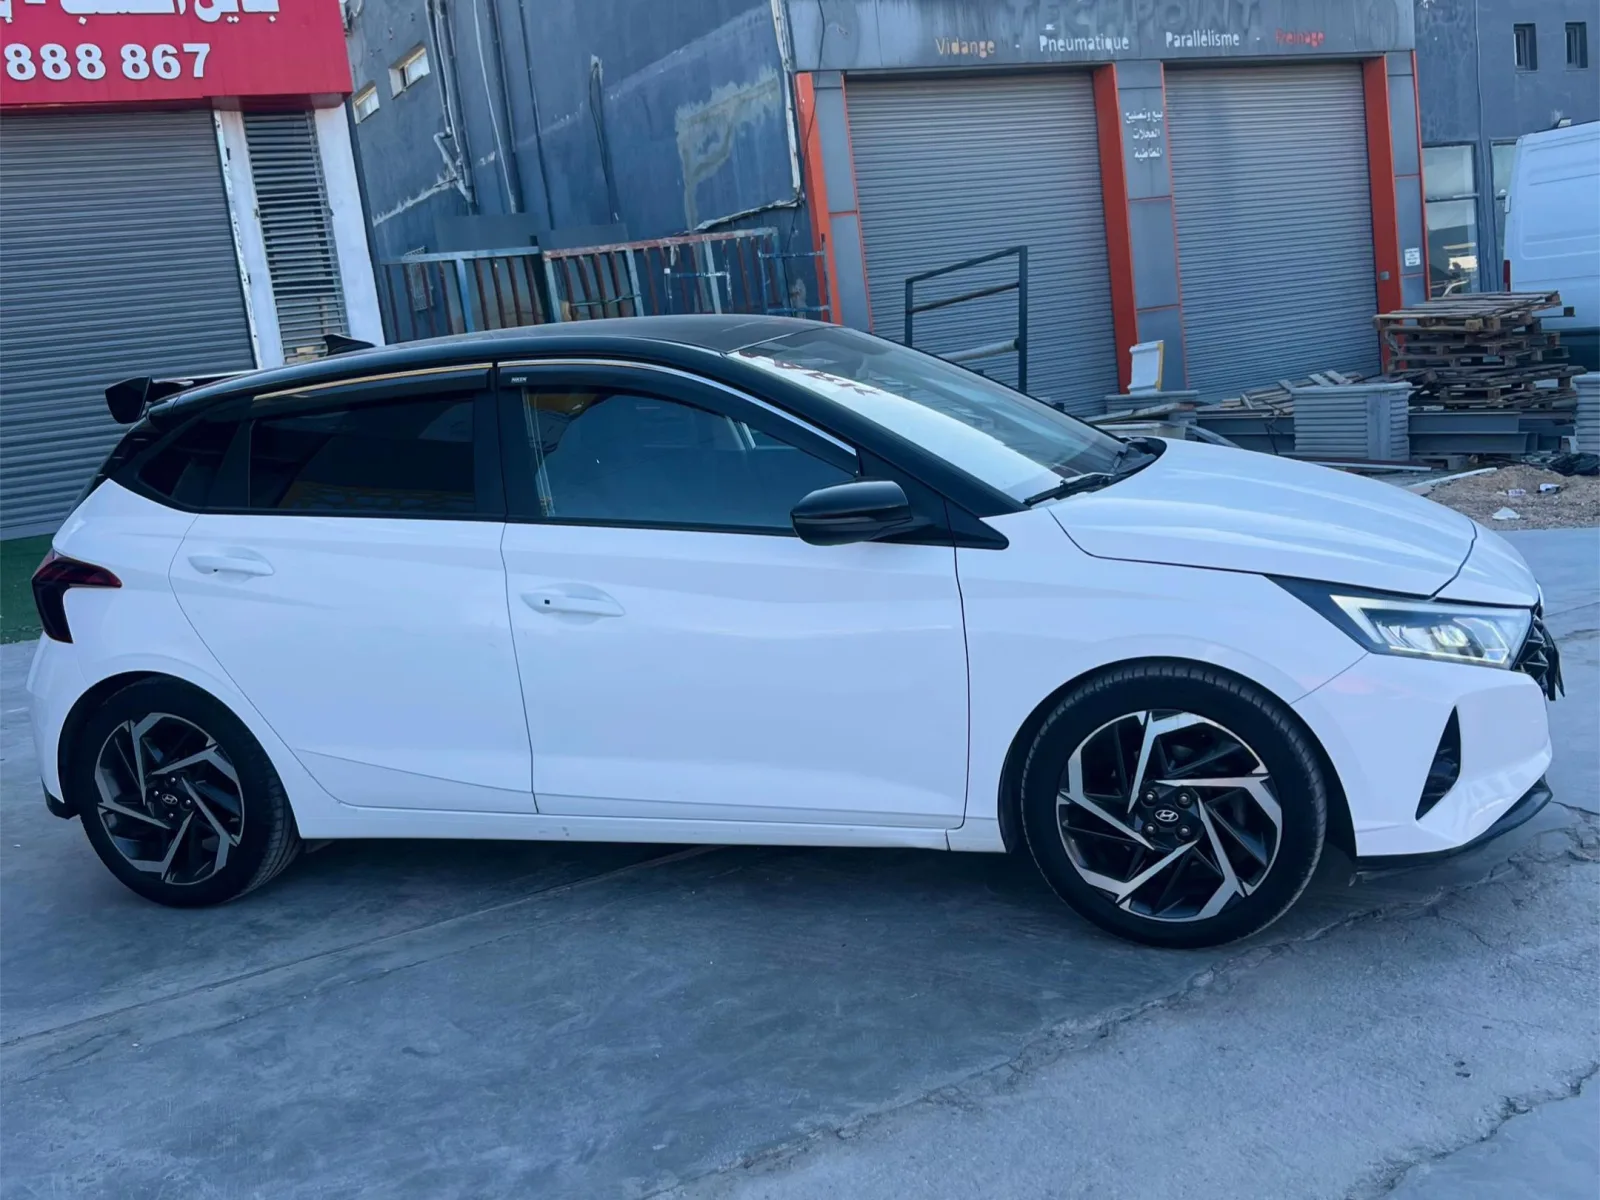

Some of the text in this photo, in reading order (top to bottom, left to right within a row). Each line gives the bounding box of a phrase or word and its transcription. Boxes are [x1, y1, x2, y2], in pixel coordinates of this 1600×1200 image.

[935, 36, 995, 59] Vidange
[1039, 34, 1130, 54] Pneumatique
[1165, 29, 1240, 48] Parallélisme
[4, 43, 211, 81] 888 867
[1132, 127, 1160, 140] العجلات
